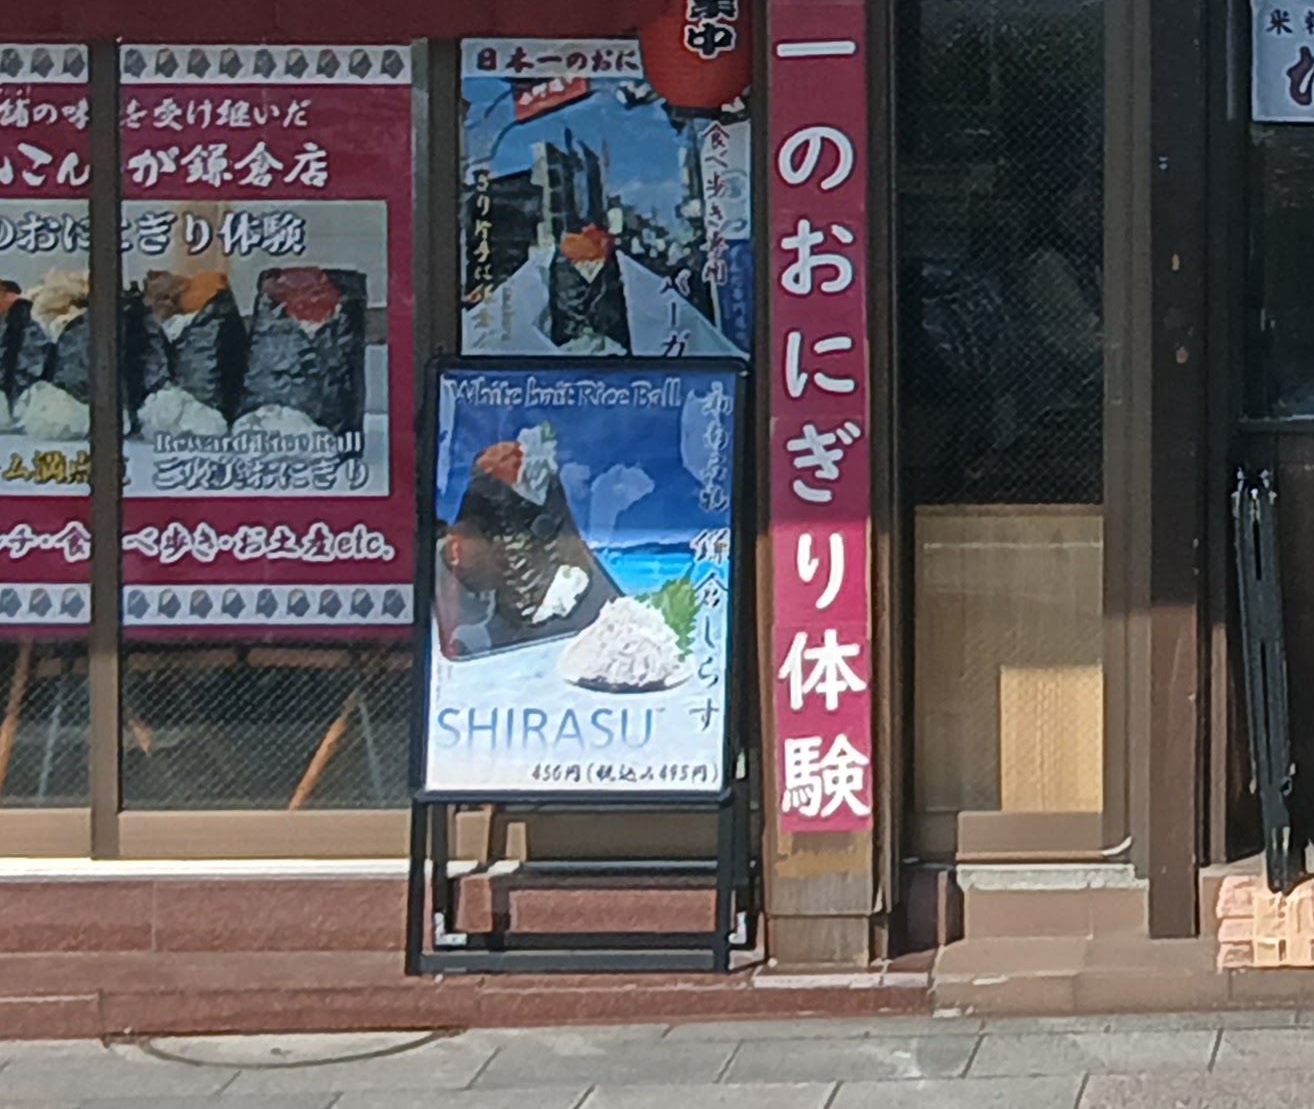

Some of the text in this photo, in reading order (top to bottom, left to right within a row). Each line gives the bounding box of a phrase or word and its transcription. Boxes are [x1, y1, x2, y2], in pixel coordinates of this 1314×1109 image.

[476, 46, 640, 72] 日本一のおに
[631, 377, 682, 407] Ball
[437, 706, 653, 750] SHIRASU
